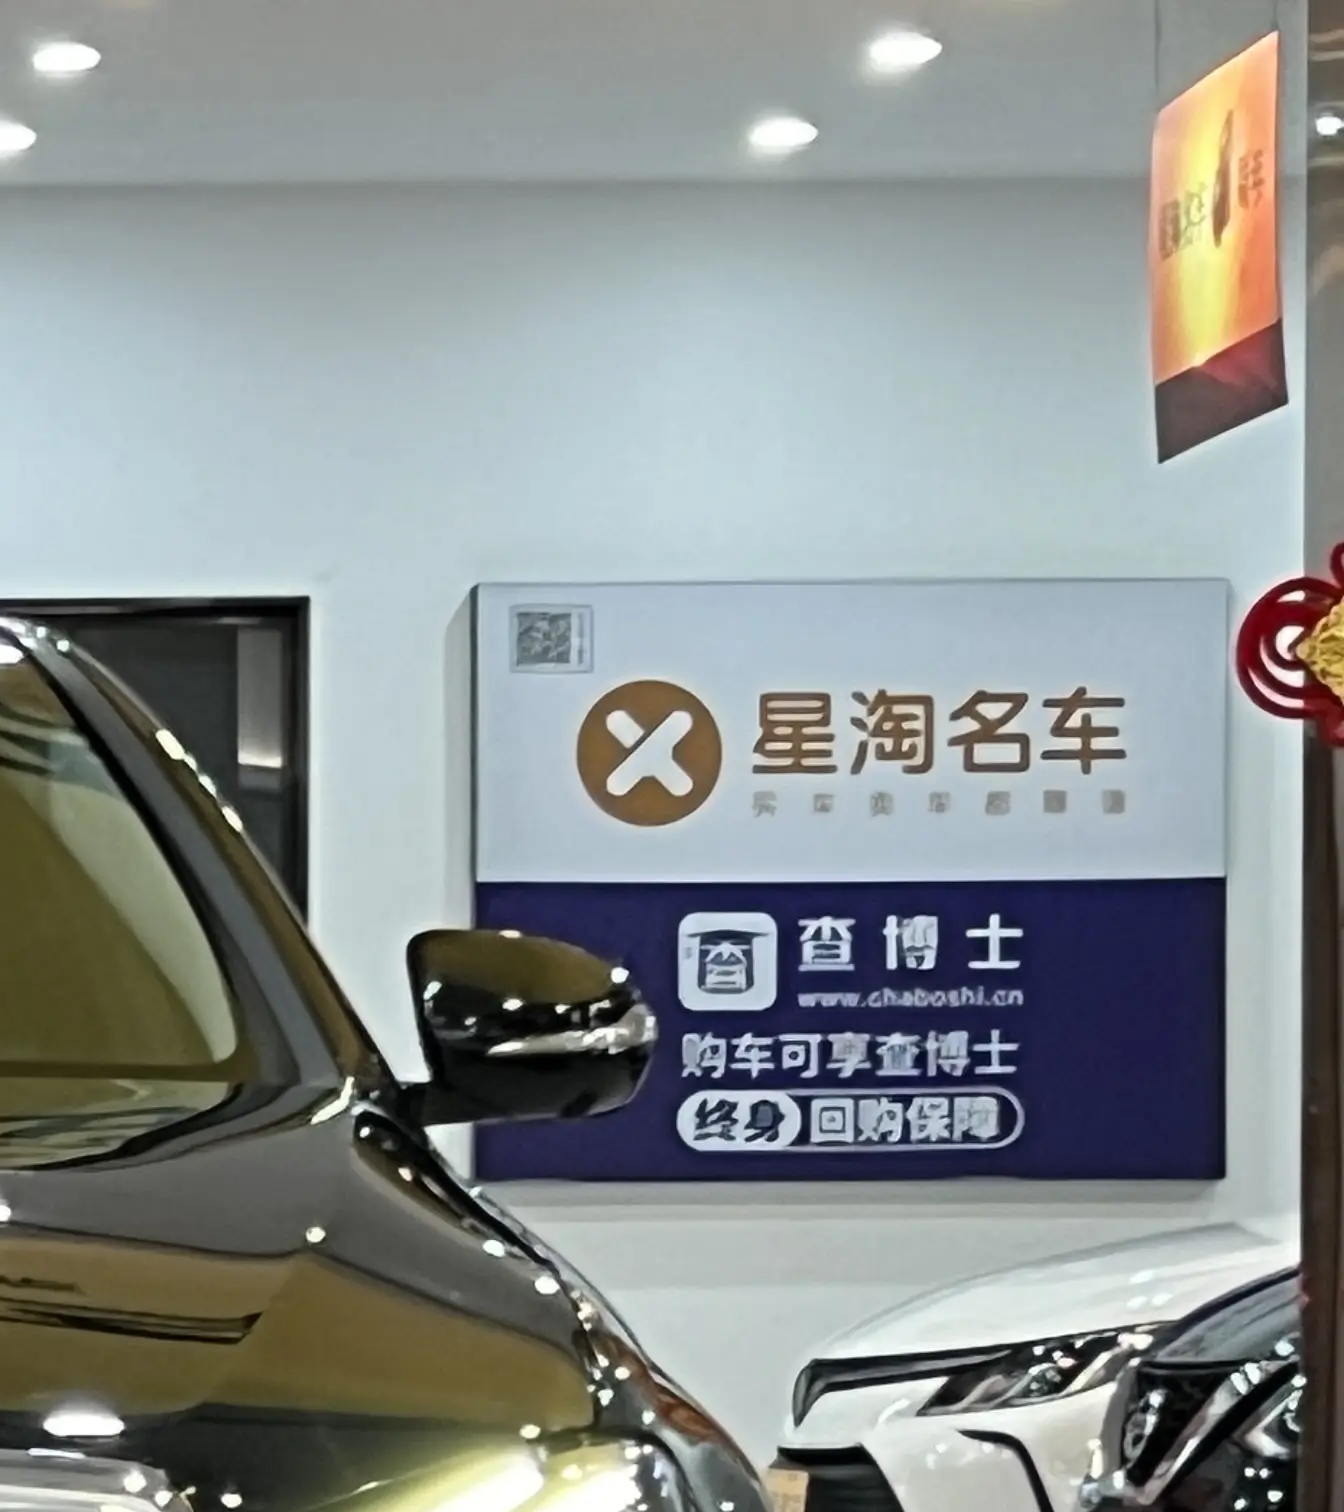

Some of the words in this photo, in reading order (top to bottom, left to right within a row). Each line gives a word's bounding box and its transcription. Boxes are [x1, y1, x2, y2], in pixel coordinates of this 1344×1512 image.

[751, 686, 1128, 776] 星淘名车
[797, 913, 1025, 972] 查博士
[680, 1028, 1020, 1079] 购车可享查博士
[692, 1098, 786, 1143] 终身
